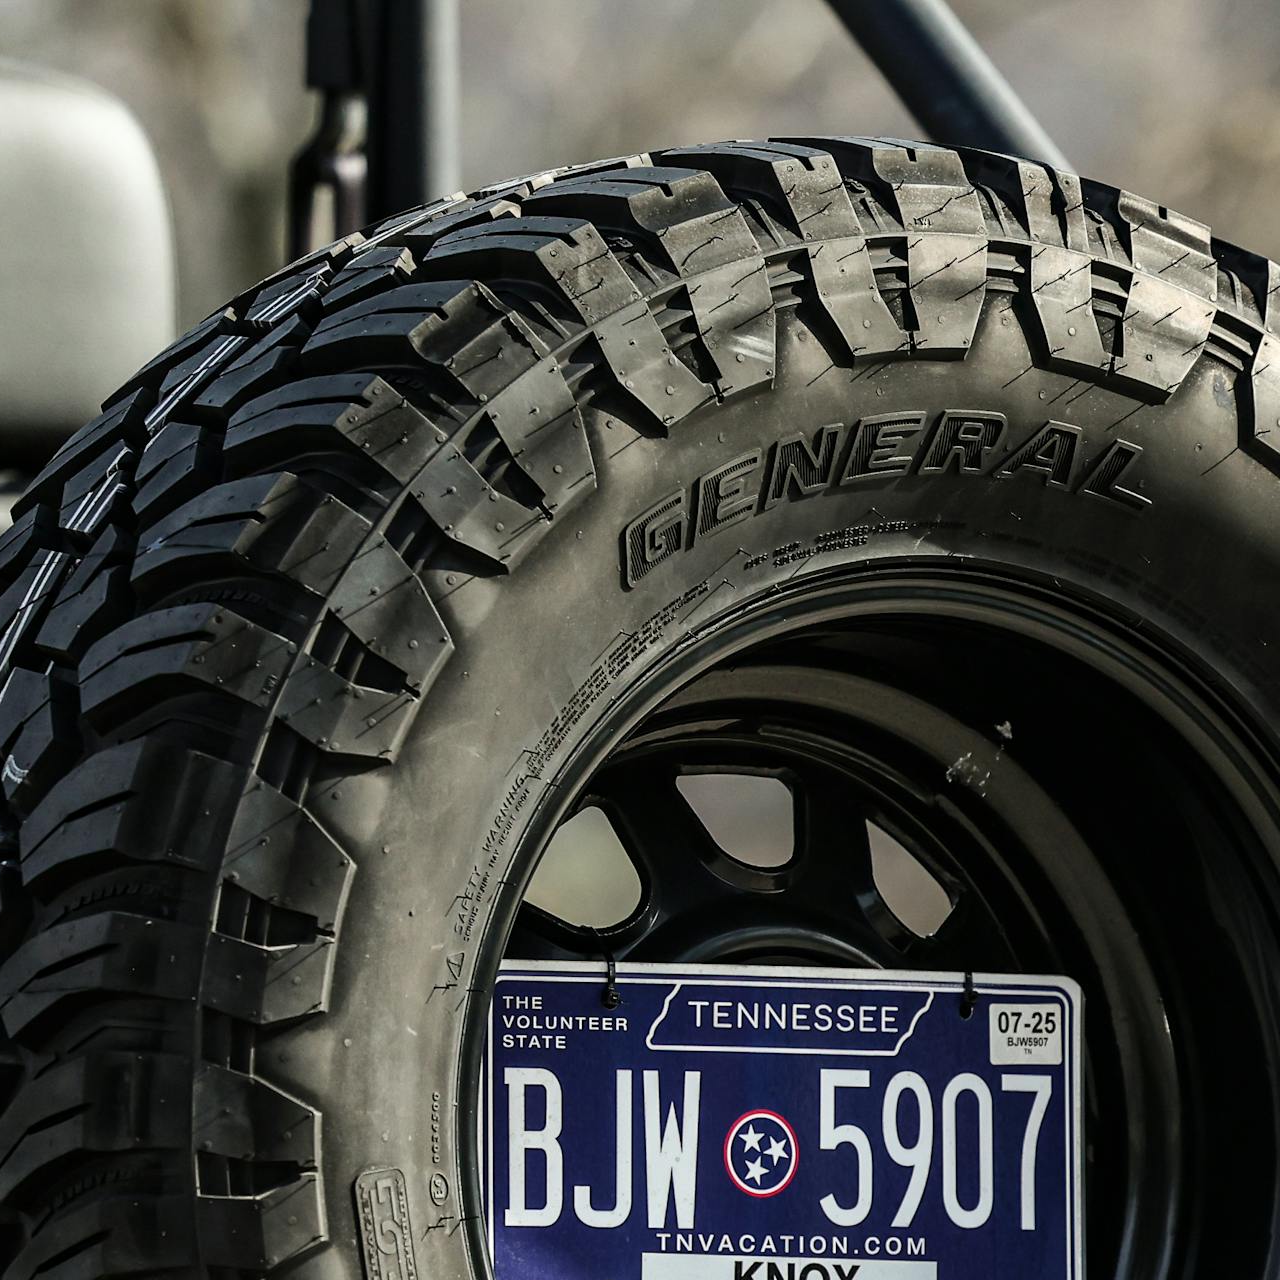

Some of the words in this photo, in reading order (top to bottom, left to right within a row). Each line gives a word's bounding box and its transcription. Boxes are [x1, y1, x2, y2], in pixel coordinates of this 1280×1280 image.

[620, 409, 1153, 588] GENERAL
[452, 864, 483, 936] SAFETY
[481, 771, 527, 854] WARNING
[503, 996, 543, 1011] THE
[503, 1016, 629, 1032] VOLUNTEER
[688, 1000, 900, 1034] TENNESSEE
[998, 1011, 1057, 1035] 07-25
[503, 1035, 567, 1050] STATE
[1007, 1037, 1048, 1048] BJW5907
[504, 1067, 701, 1229] BJW
[819, 1069, 1053, 1231] 5907
[656, 1233, 927, 1256] TNVACATION.COM
